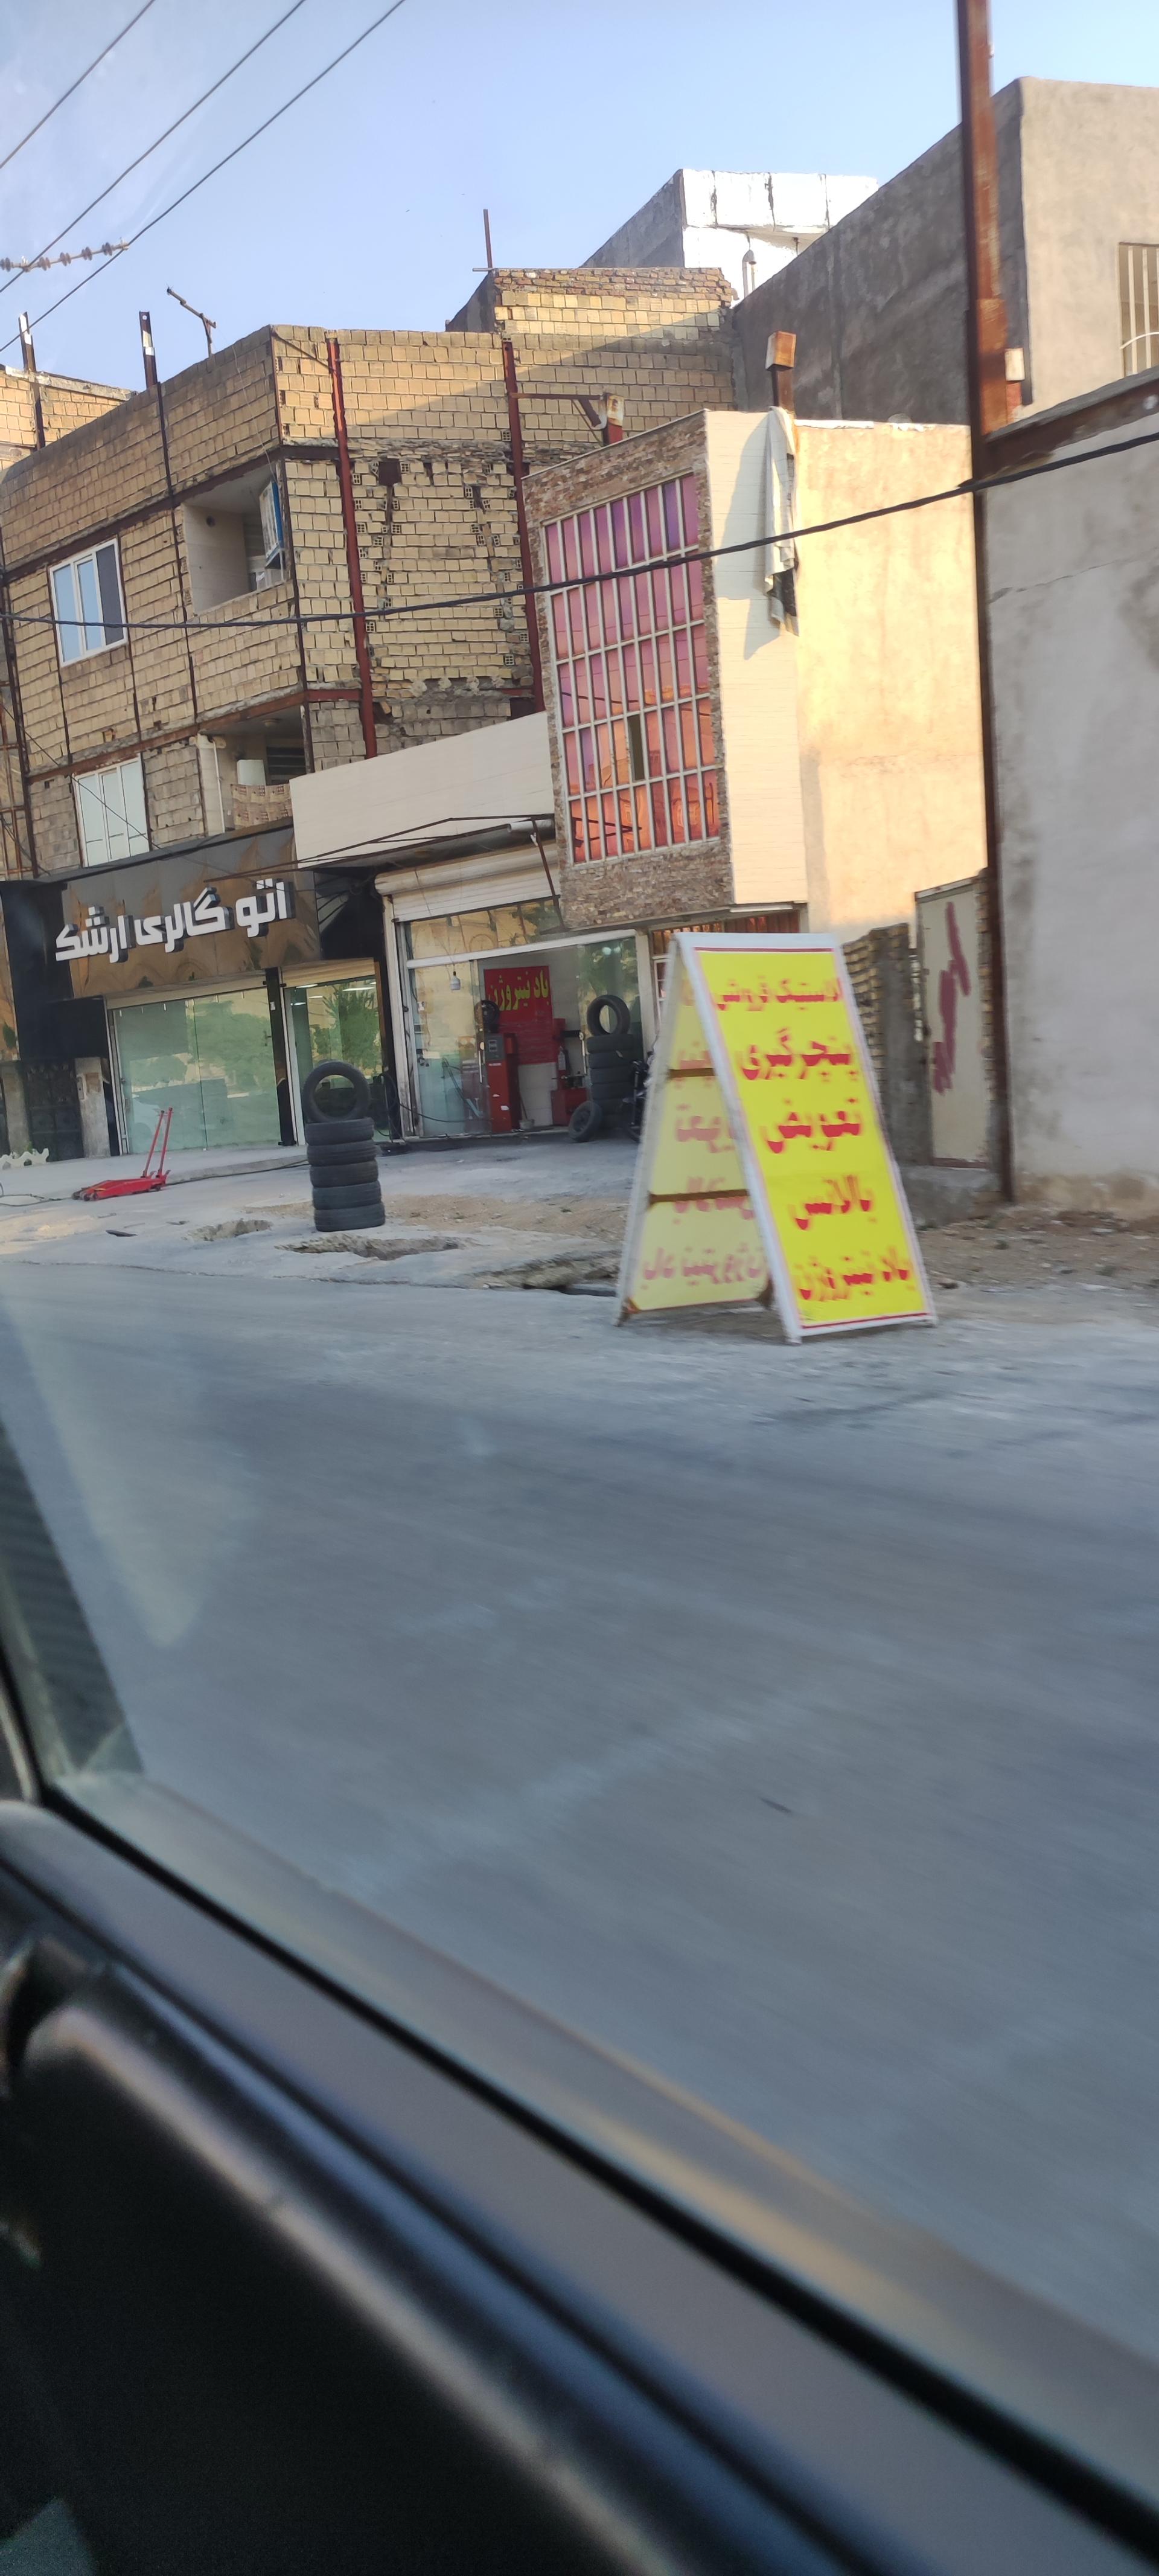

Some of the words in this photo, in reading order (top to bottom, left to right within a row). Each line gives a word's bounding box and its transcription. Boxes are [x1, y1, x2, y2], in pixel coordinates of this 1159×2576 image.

[55, 906, 127, 963] ارشک
[134, 886, 227, 953] گالری
[235, 879, 288, 938] اتو
[534, 970, 549, 1005] باد
[759, 1097, 862, 1155] تعویض
[788, 1175, 876, 1231] بالانس
